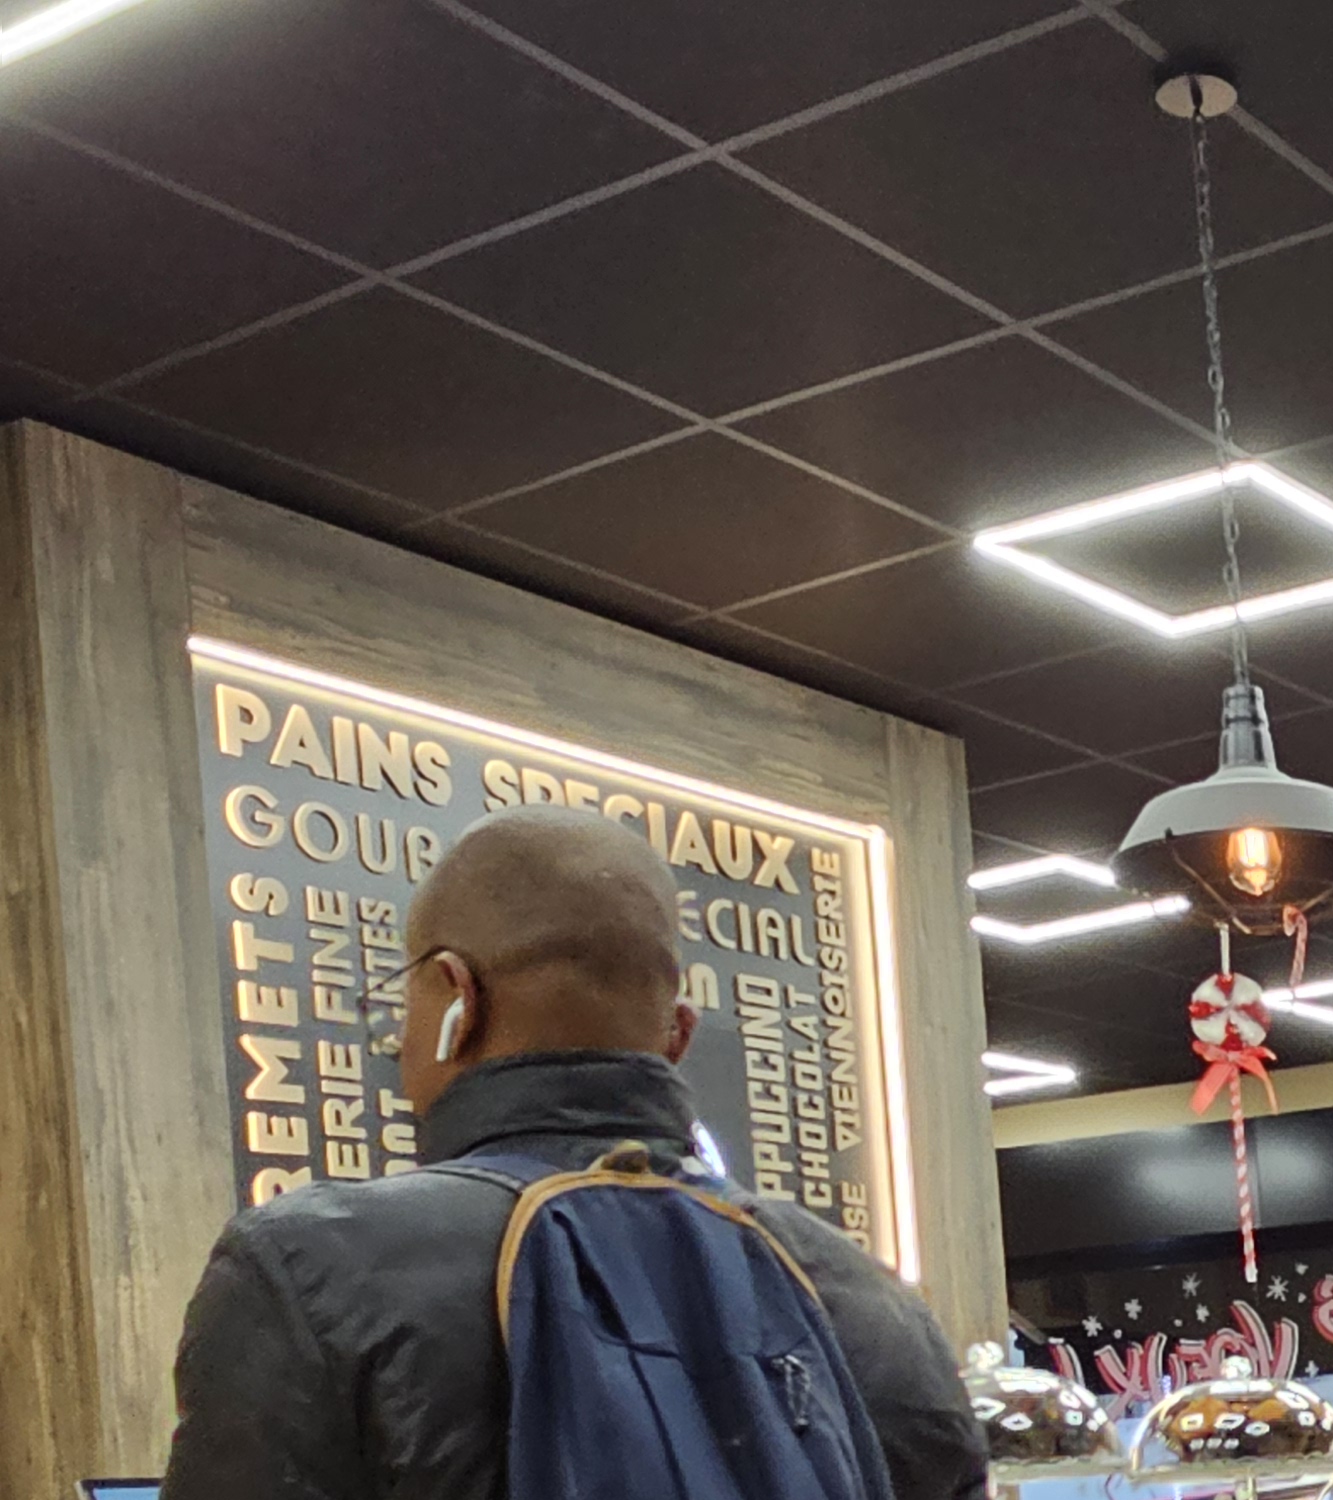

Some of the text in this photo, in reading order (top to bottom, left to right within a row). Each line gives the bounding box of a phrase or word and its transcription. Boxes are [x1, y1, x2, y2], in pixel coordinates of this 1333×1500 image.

[215, 683, 452, 806] PAINS
[224, 785, 816, 966] GOUR ECIAL
[231, 872, 311, 1208] REMETS
[305, 885, 371, 1181] ERIE FINE
[737, 973, 796, 1202] PPUCCINO
[787, 984, 833, 1209] CHOCOLAT
[812, 847, 863, 1152] VIENNOISERIE
